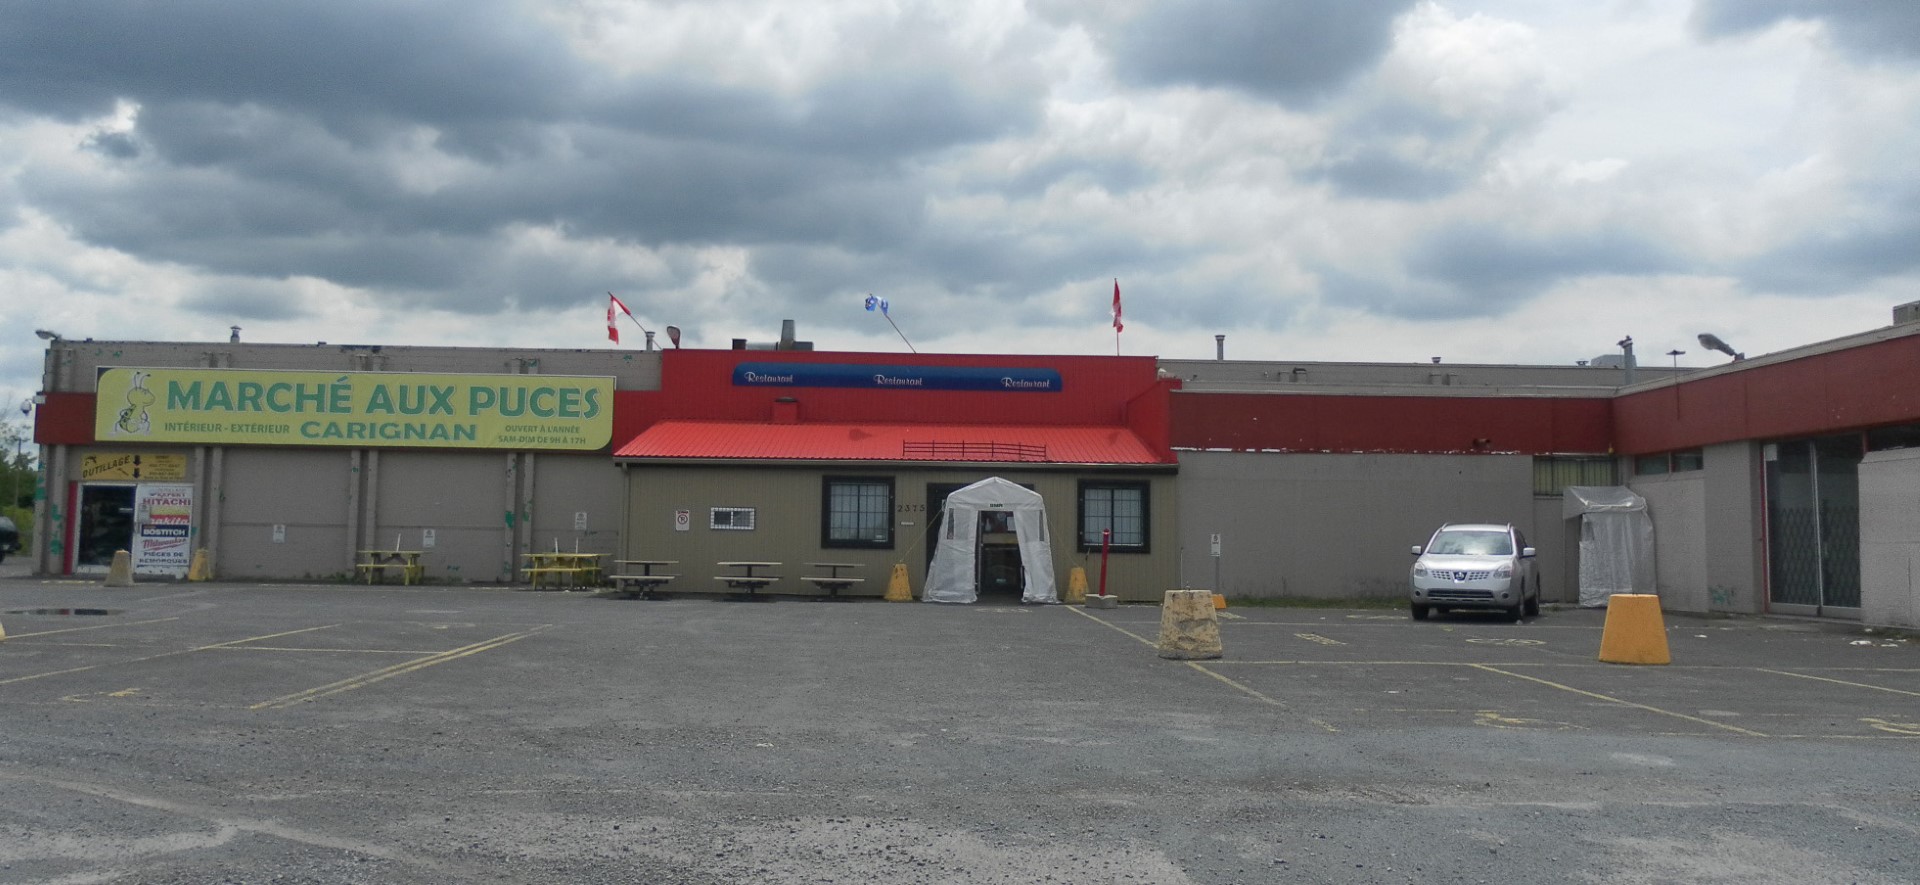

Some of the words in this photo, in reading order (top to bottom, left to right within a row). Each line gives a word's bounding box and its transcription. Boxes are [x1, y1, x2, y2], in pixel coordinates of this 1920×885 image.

[744, 371, 794, 384] Restaurant
[873, 374, 923, 387] Restaurant
[1000, 376, 1050, 390] Restaurant
[166, 375, 353, 414] MARCHÉ
[365, 384, 455, 416] AUX
[468, 386, 601, 419] PUCES
[164, 422, 222, 433] INTÉRIEUR
[230, 422, 290, 435] EXTÉRIEUR
[300, 421, 478, 441] CARIGNAN
[505, 425, 538, 433] OUVERT
[498, 435, 536, 443] SAM-DIM
[537, 436, 549, 444] DE
[550, 436, 561, 444] 9H
[570, 436, 586, 445] 17H
[82, 454, 131, 479] OUTILLAGE
[143, 498, 191, 506] HITACHI
[897, 504, 926, 513] 2375
